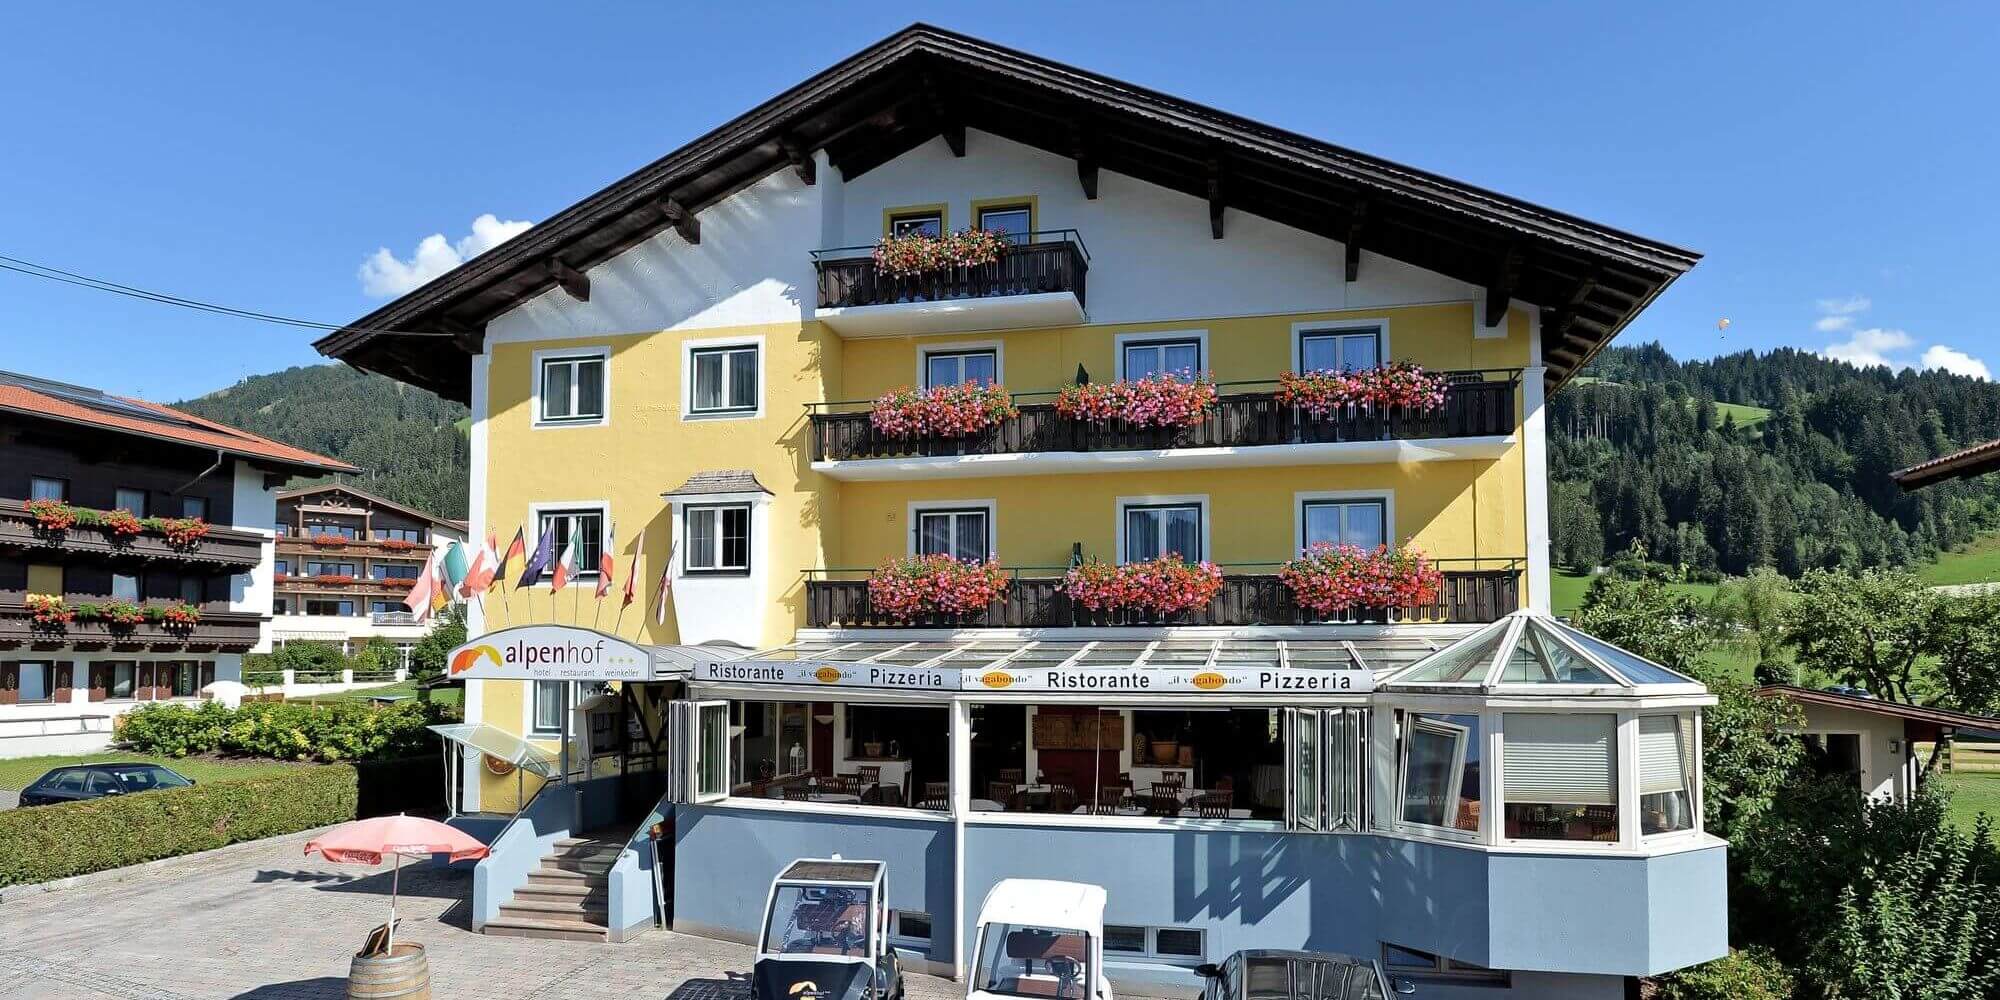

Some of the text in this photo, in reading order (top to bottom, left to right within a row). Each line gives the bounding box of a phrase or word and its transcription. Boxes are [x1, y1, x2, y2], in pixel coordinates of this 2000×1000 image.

[506, 640, 604, 670] alpenhof
[533, 668, 639, 677] hotel restaurant weinkeller
[709, 663, 785, 681] Ristorante
[870, 668, 942, 686] Pizzeria
[1047, 672, 1150, 689] Ristorante
[1260, 672, 1351, 690] Pizzeria
